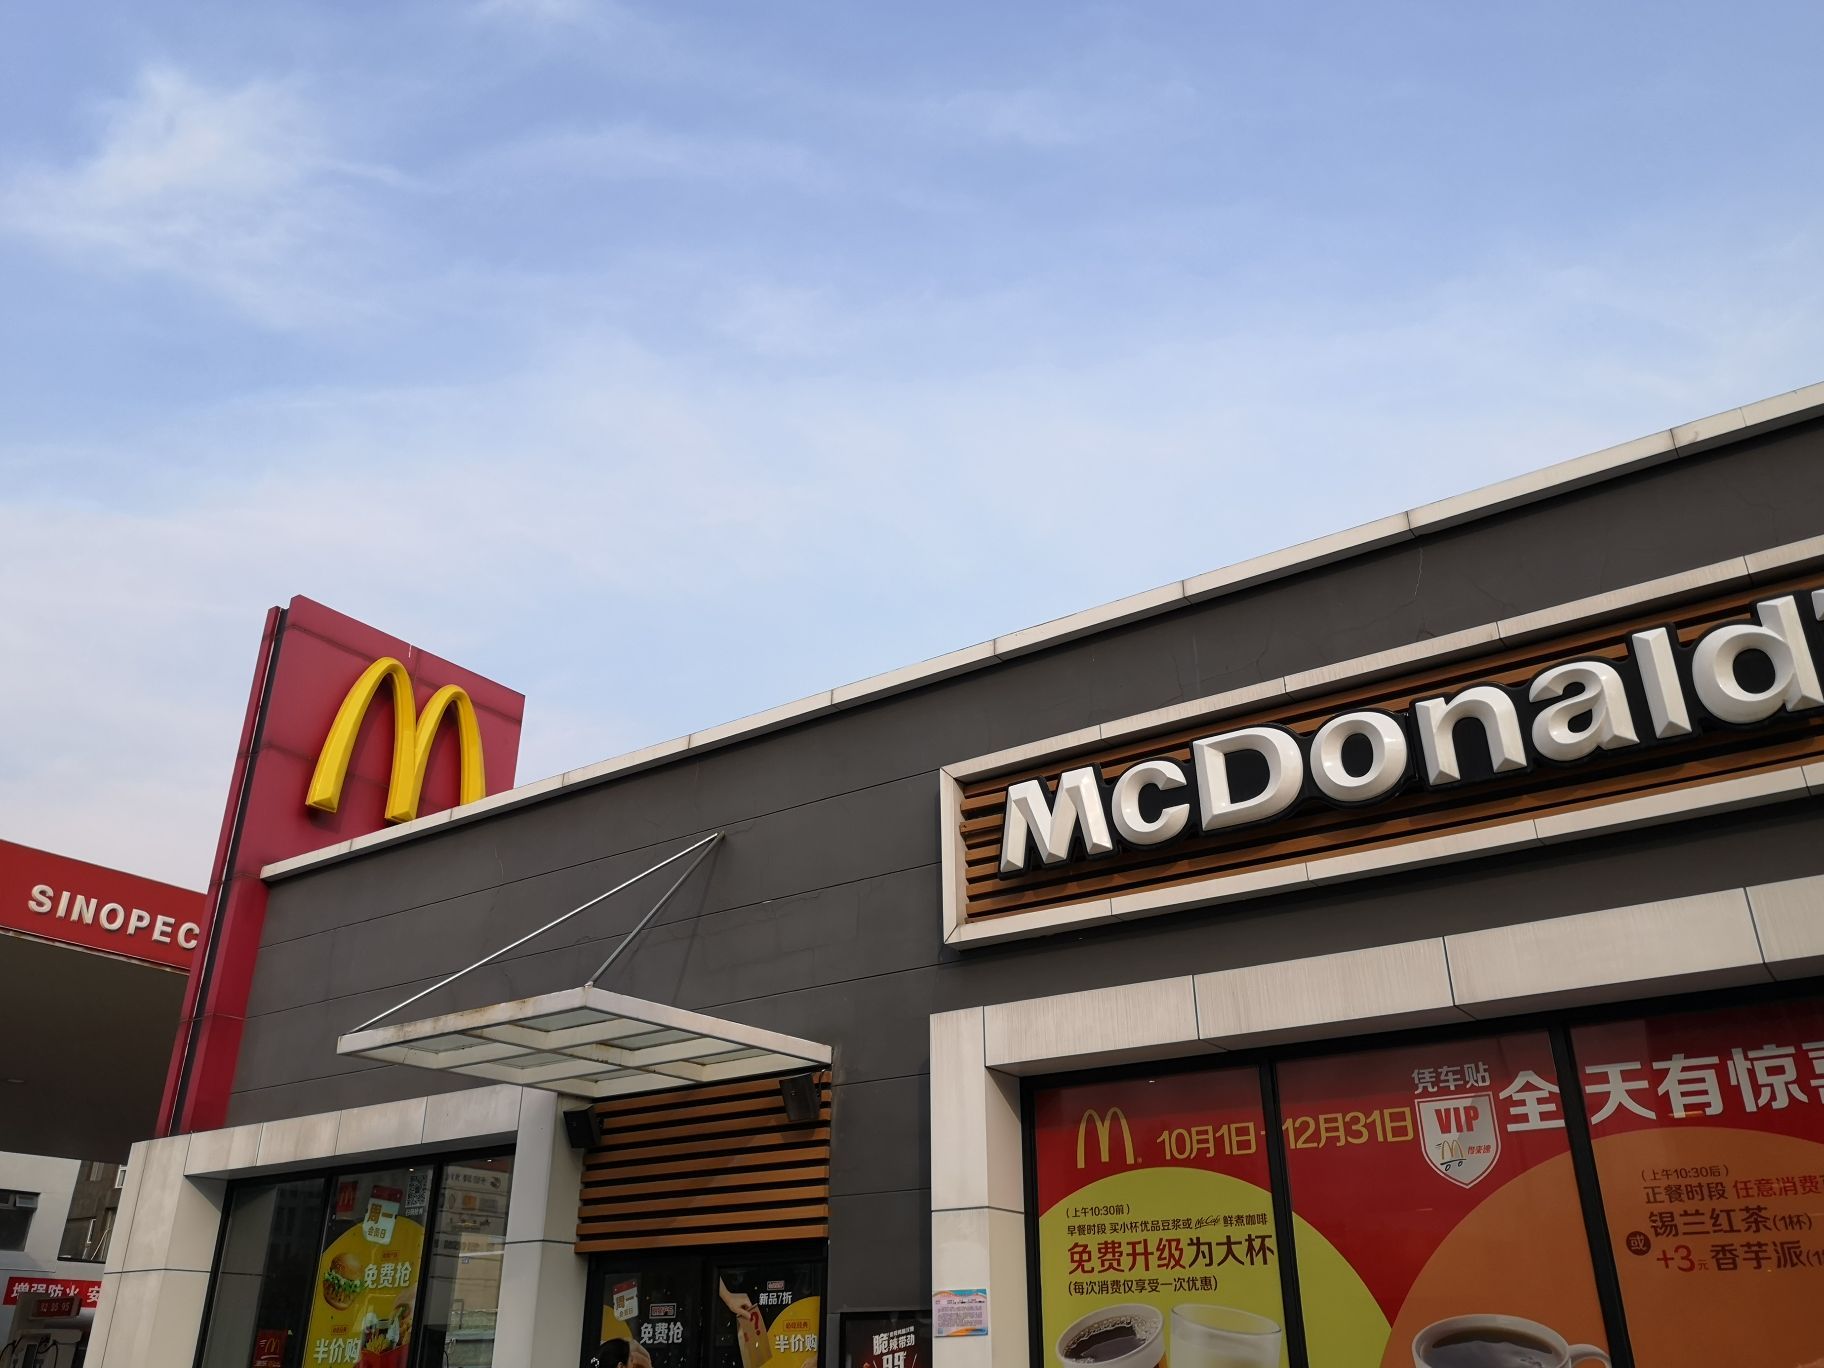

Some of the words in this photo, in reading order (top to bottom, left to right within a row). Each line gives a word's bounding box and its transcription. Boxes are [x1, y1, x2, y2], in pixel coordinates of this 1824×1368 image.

[28, 884, 200, 949] SINOPEC
[1411, 1061, 1491, 1094] 凭车贴
[1434, 1105, 1480, 1134] VIP
[1641, 1164, 1729, 1182] (上午10:30后)
[1643, 1182, 1728, 1204] 正餐时段
[1732, 1174, 1824, 1200] 任意消费
[366, 1203, 394, 1225] 周一
[1066, 1203, 1131, 1219] (上午10:30前)
[367, 1226, 387, 1239] 会员日
[1067, 1222, 1107, 1237] 早餐时段
[1109, 1218, 1192, 1234] 买小杯优品豆浆或
[1222, 1212, 1268, 1228] 鲜煮咖啡
[1067, 1233, 1275, 1275] 免费升级为大杯
[1629, 1235, 1648, 1250] 或
[363, 1261, 412, 1288] 免费抢
[1068, 1275, 1218, 1297] (每次消费仅享受一次优惠)
[759, 1291, 793, 1306] 新品7折
[640, 1321, 684, 1344] 免费抢
[775, 1333, 818, 1353] 半价购
[313, 1338, 362, 1364] 半价购
